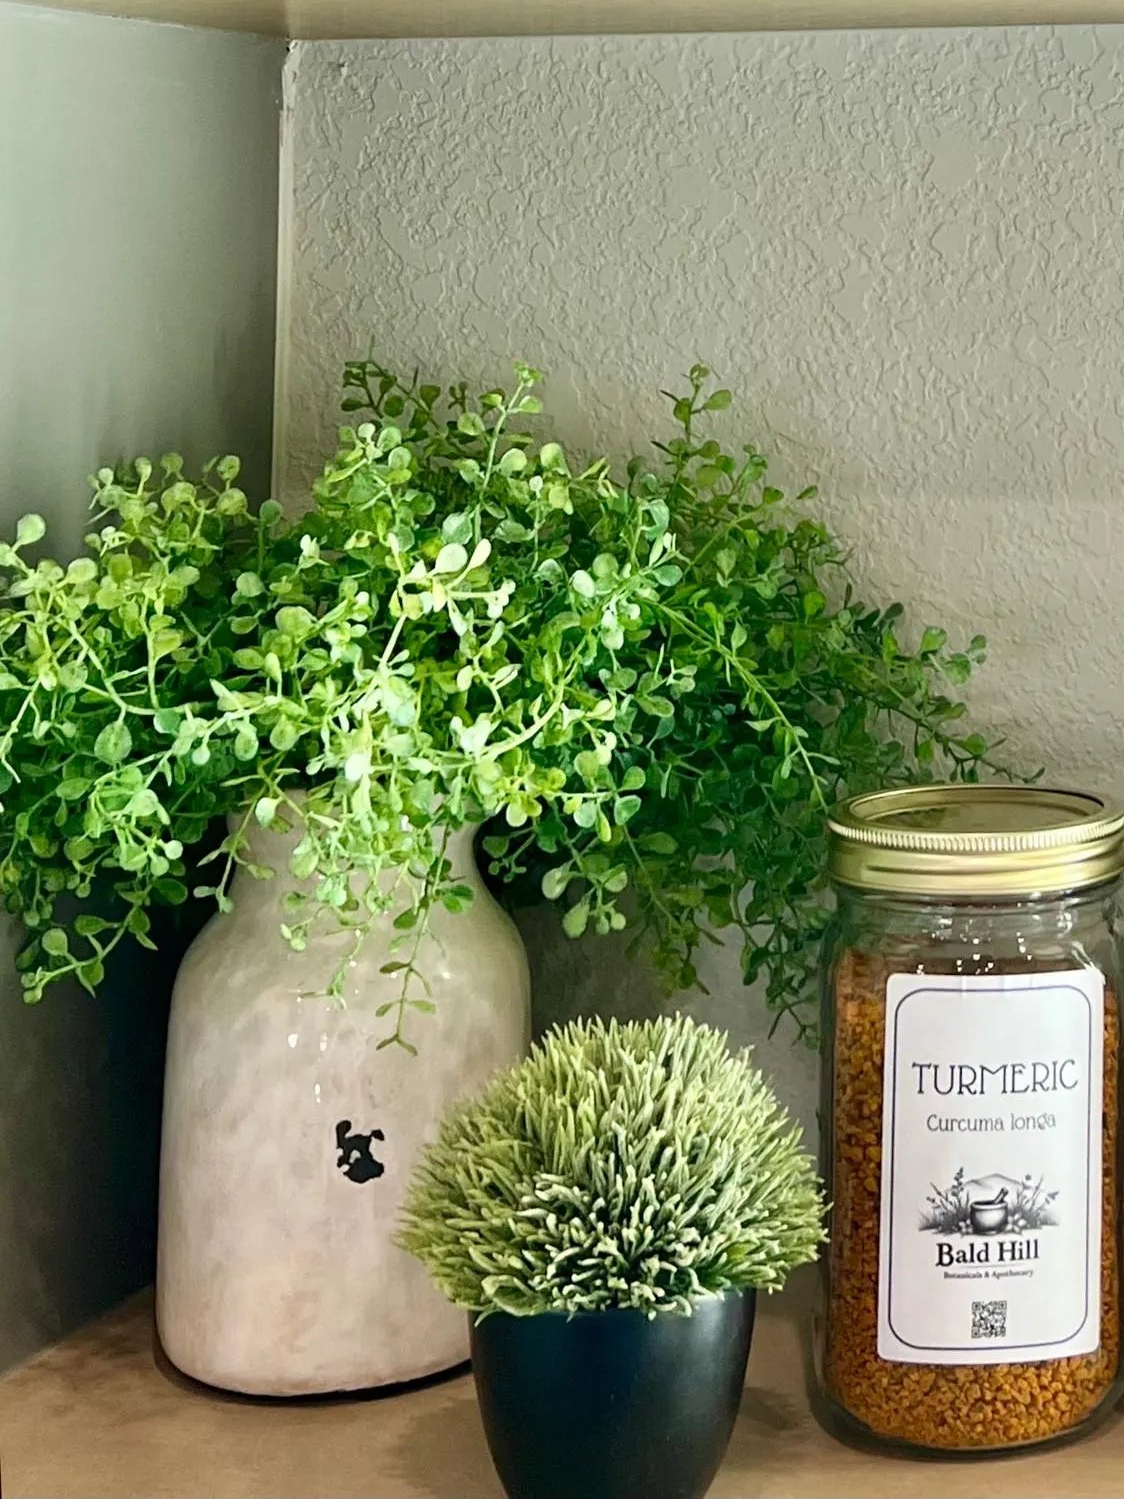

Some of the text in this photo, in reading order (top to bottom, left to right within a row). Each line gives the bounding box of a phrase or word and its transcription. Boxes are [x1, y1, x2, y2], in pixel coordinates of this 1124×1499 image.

[911, 1058, 1079, 1097] TURMERIC
[926, 1112, 1056, 1133] Curcuma longa
[935, 1239, 1040, 1267] Bald Hill
